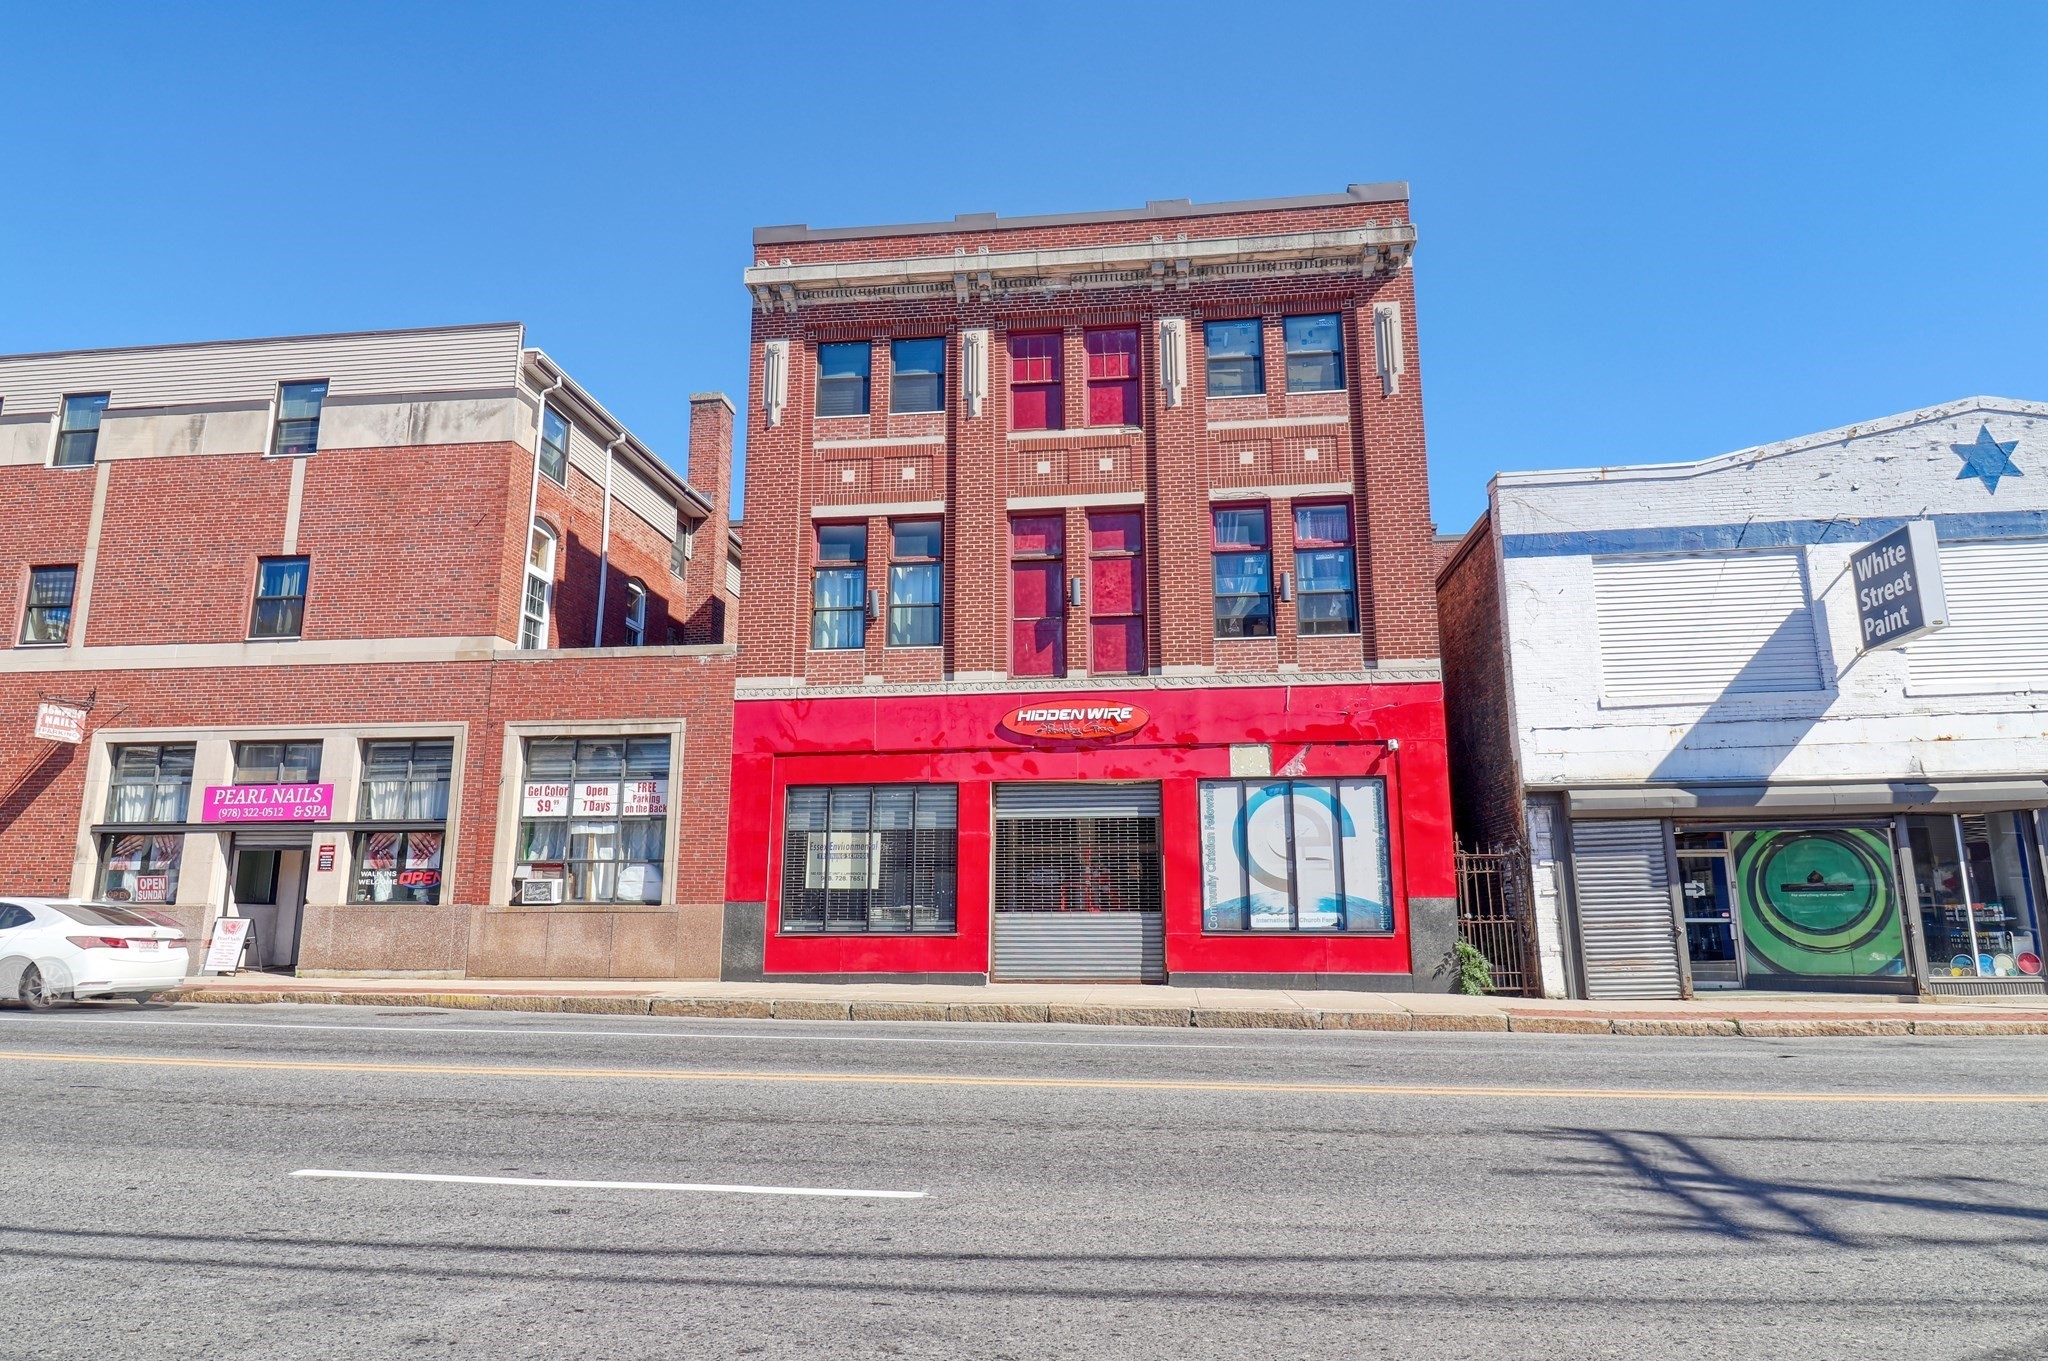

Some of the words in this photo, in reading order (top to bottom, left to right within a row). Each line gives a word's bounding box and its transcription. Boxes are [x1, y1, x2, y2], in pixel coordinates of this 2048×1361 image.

[1855, 544, 1907, 582] White
[1860, 571, 1913, 612] Street
[1864, 605, 1910, 641] Paint
[1017, 708, 1085, 722] HIDDEN
[1087, 707, 1134, 722] WIRE
[44, 715, 78, 729] NAILS
[41, 728, 78, 738] PARKING
[528, 785, 542, 797] Gel
[544, 785, 569, 797] Color
[585, 785, 609, 798] Open
[637, 781, 657, 793] FREE
[213, 789, 268, 805] PEARL
[270, 787, 323, 804] NAILS
[632, 794, 661, 804] Parking
[583, 801, 588, 812] 7
[589, 800, 611, 812] Days
[625, 805, 635, 813] on
[635, 804, 648, 813] the
[649, 804, 667, 813] Back
[1203, 782, 1216, 831] Fellowship
[218, 808, 240, 819] (978)
[243, 807, 284, 817] 322-0512
[829, 840, 879, 851] Environmenal
[1205, 832, 1217, 874] Christian
[140, 878, 166, 890] OPEN
[398, 871, 441, 885] OPEN
[107, 889, 129, 899] OPEN
[138, 890, 167, 900] SUNDAY
[1206, 874, 1219, 930] Community
